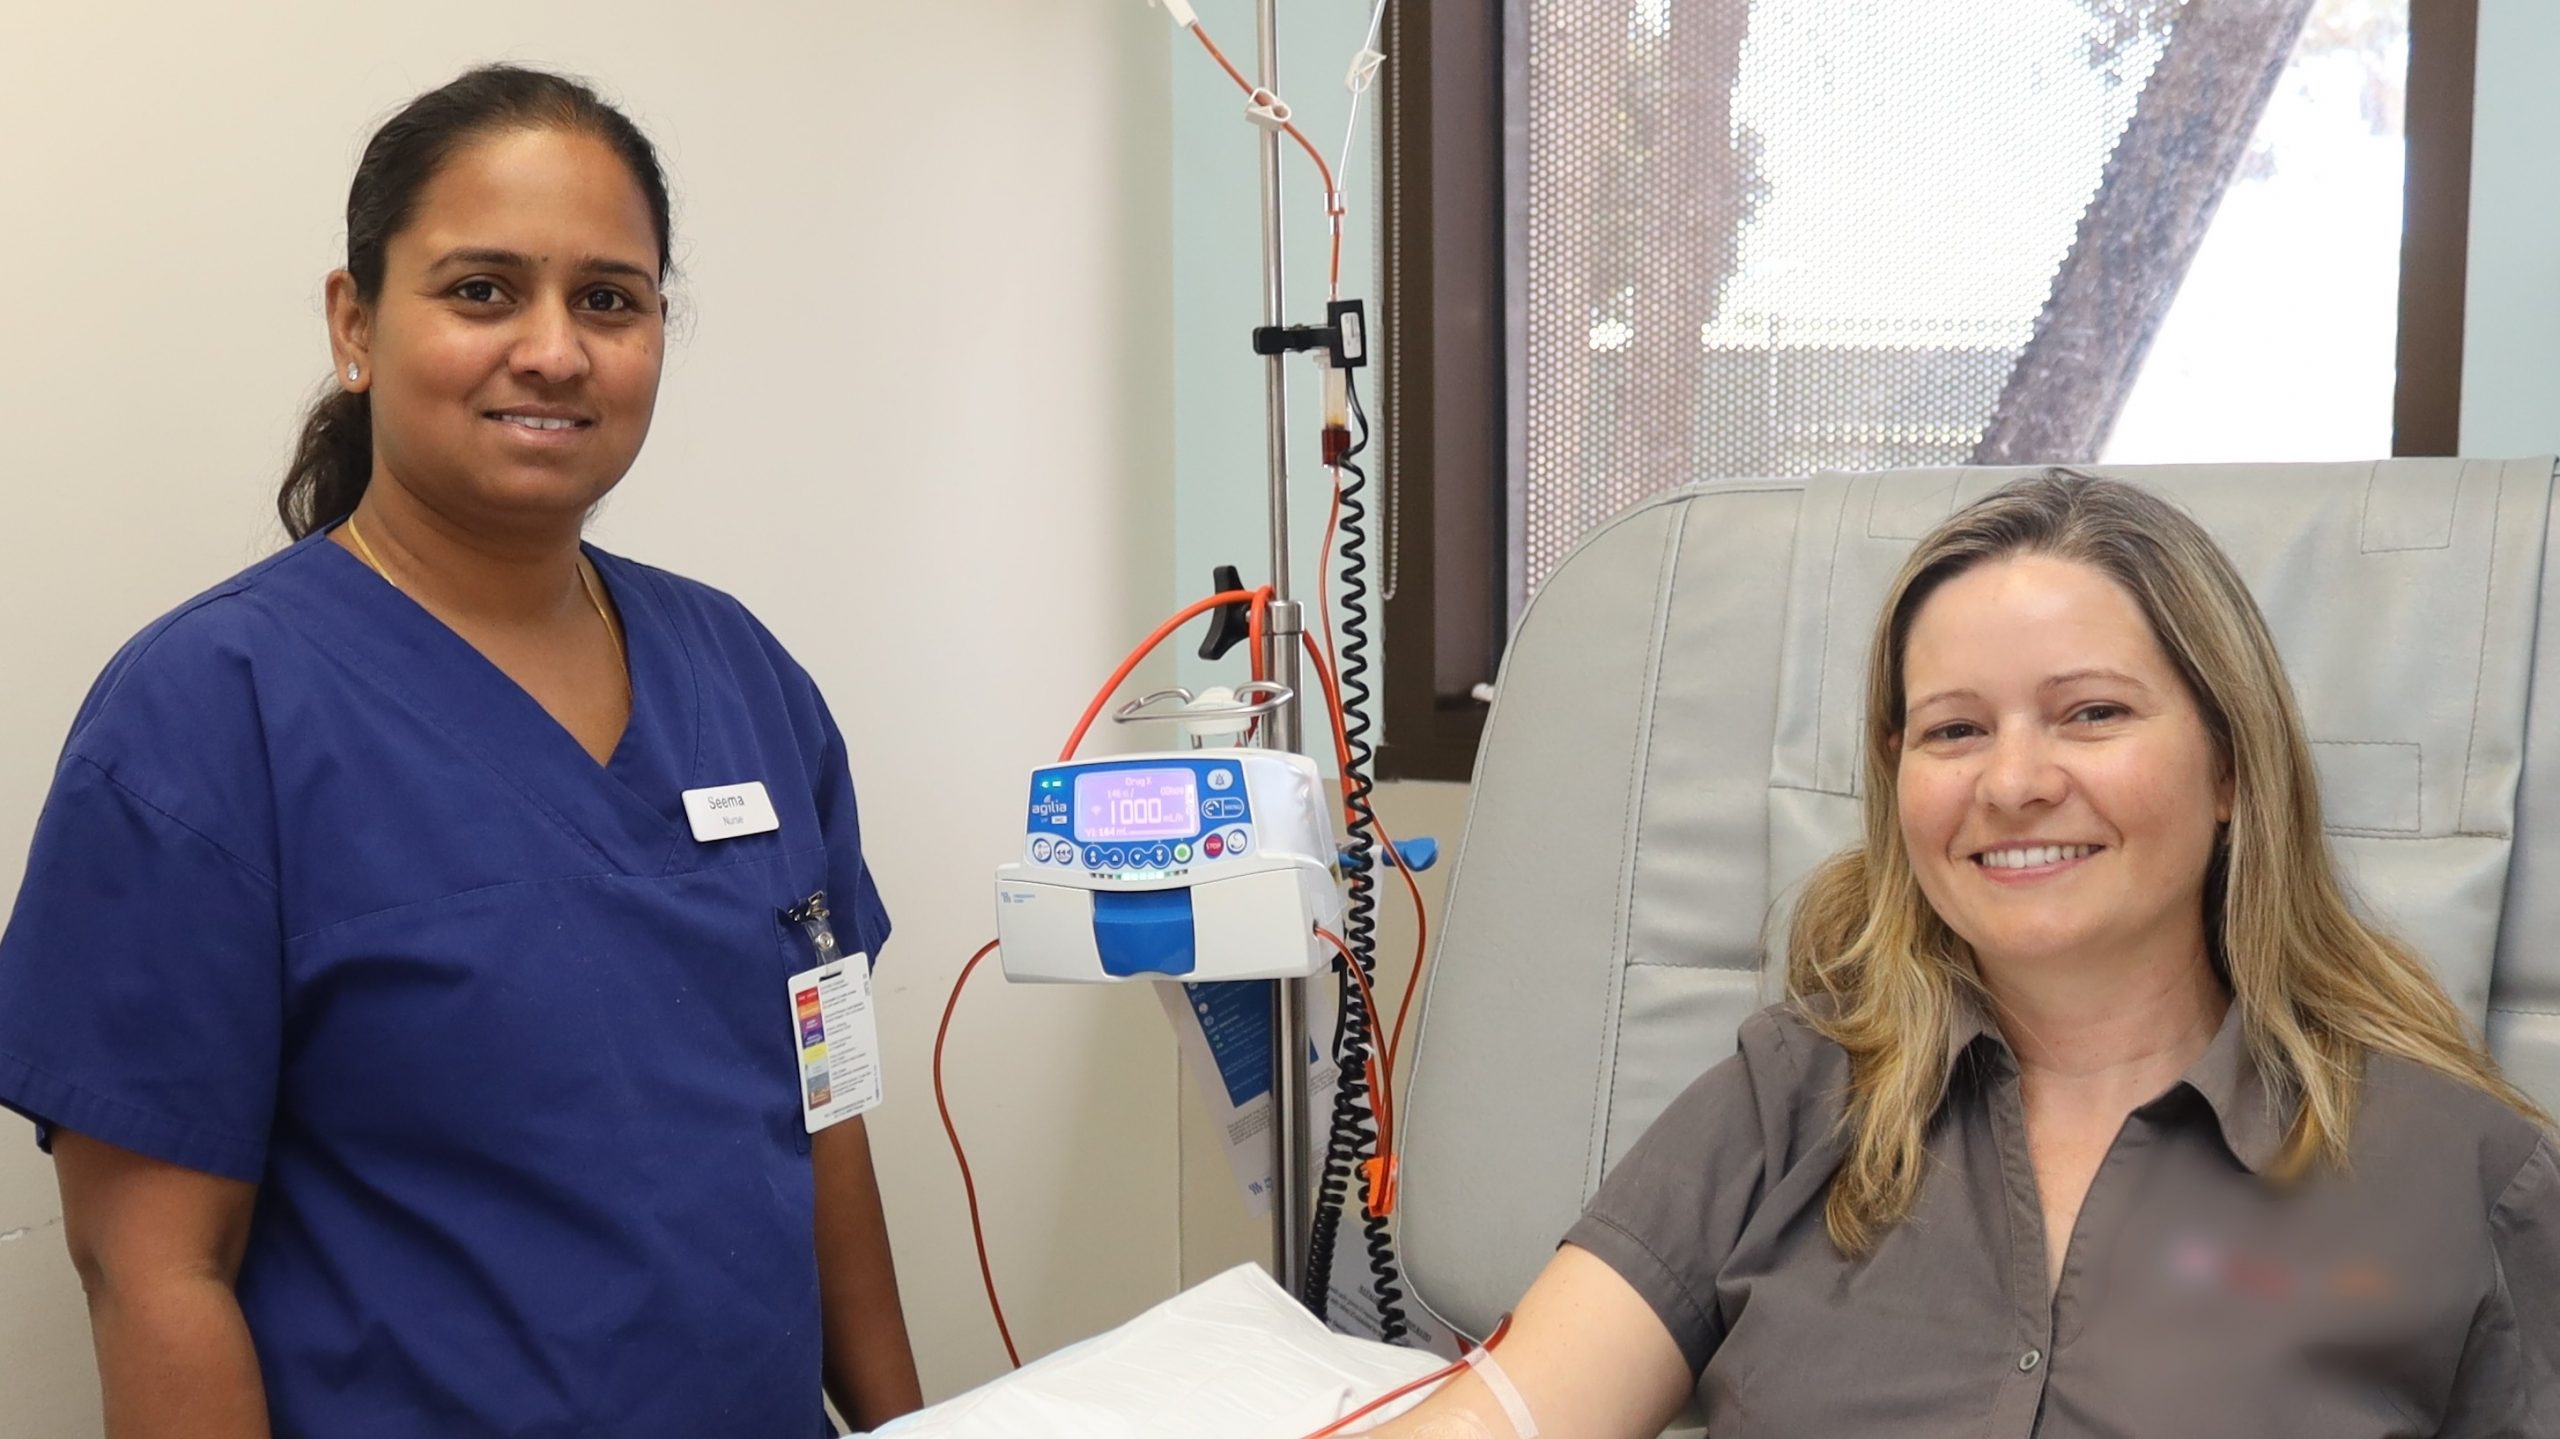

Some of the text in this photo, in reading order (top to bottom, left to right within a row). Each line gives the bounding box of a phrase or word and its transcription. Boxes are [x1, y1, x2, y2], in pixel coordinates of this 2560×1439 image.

[1125, 777, 1146, 787] Drug
[707, 795, 745, 810] Seema
[1032, 799, 1067, 817] agilia
[1110, 797, 1162, 825] 1000
[722, 816, 745, 826] Nurse
[1206, 842, 1222, 851] STOP
